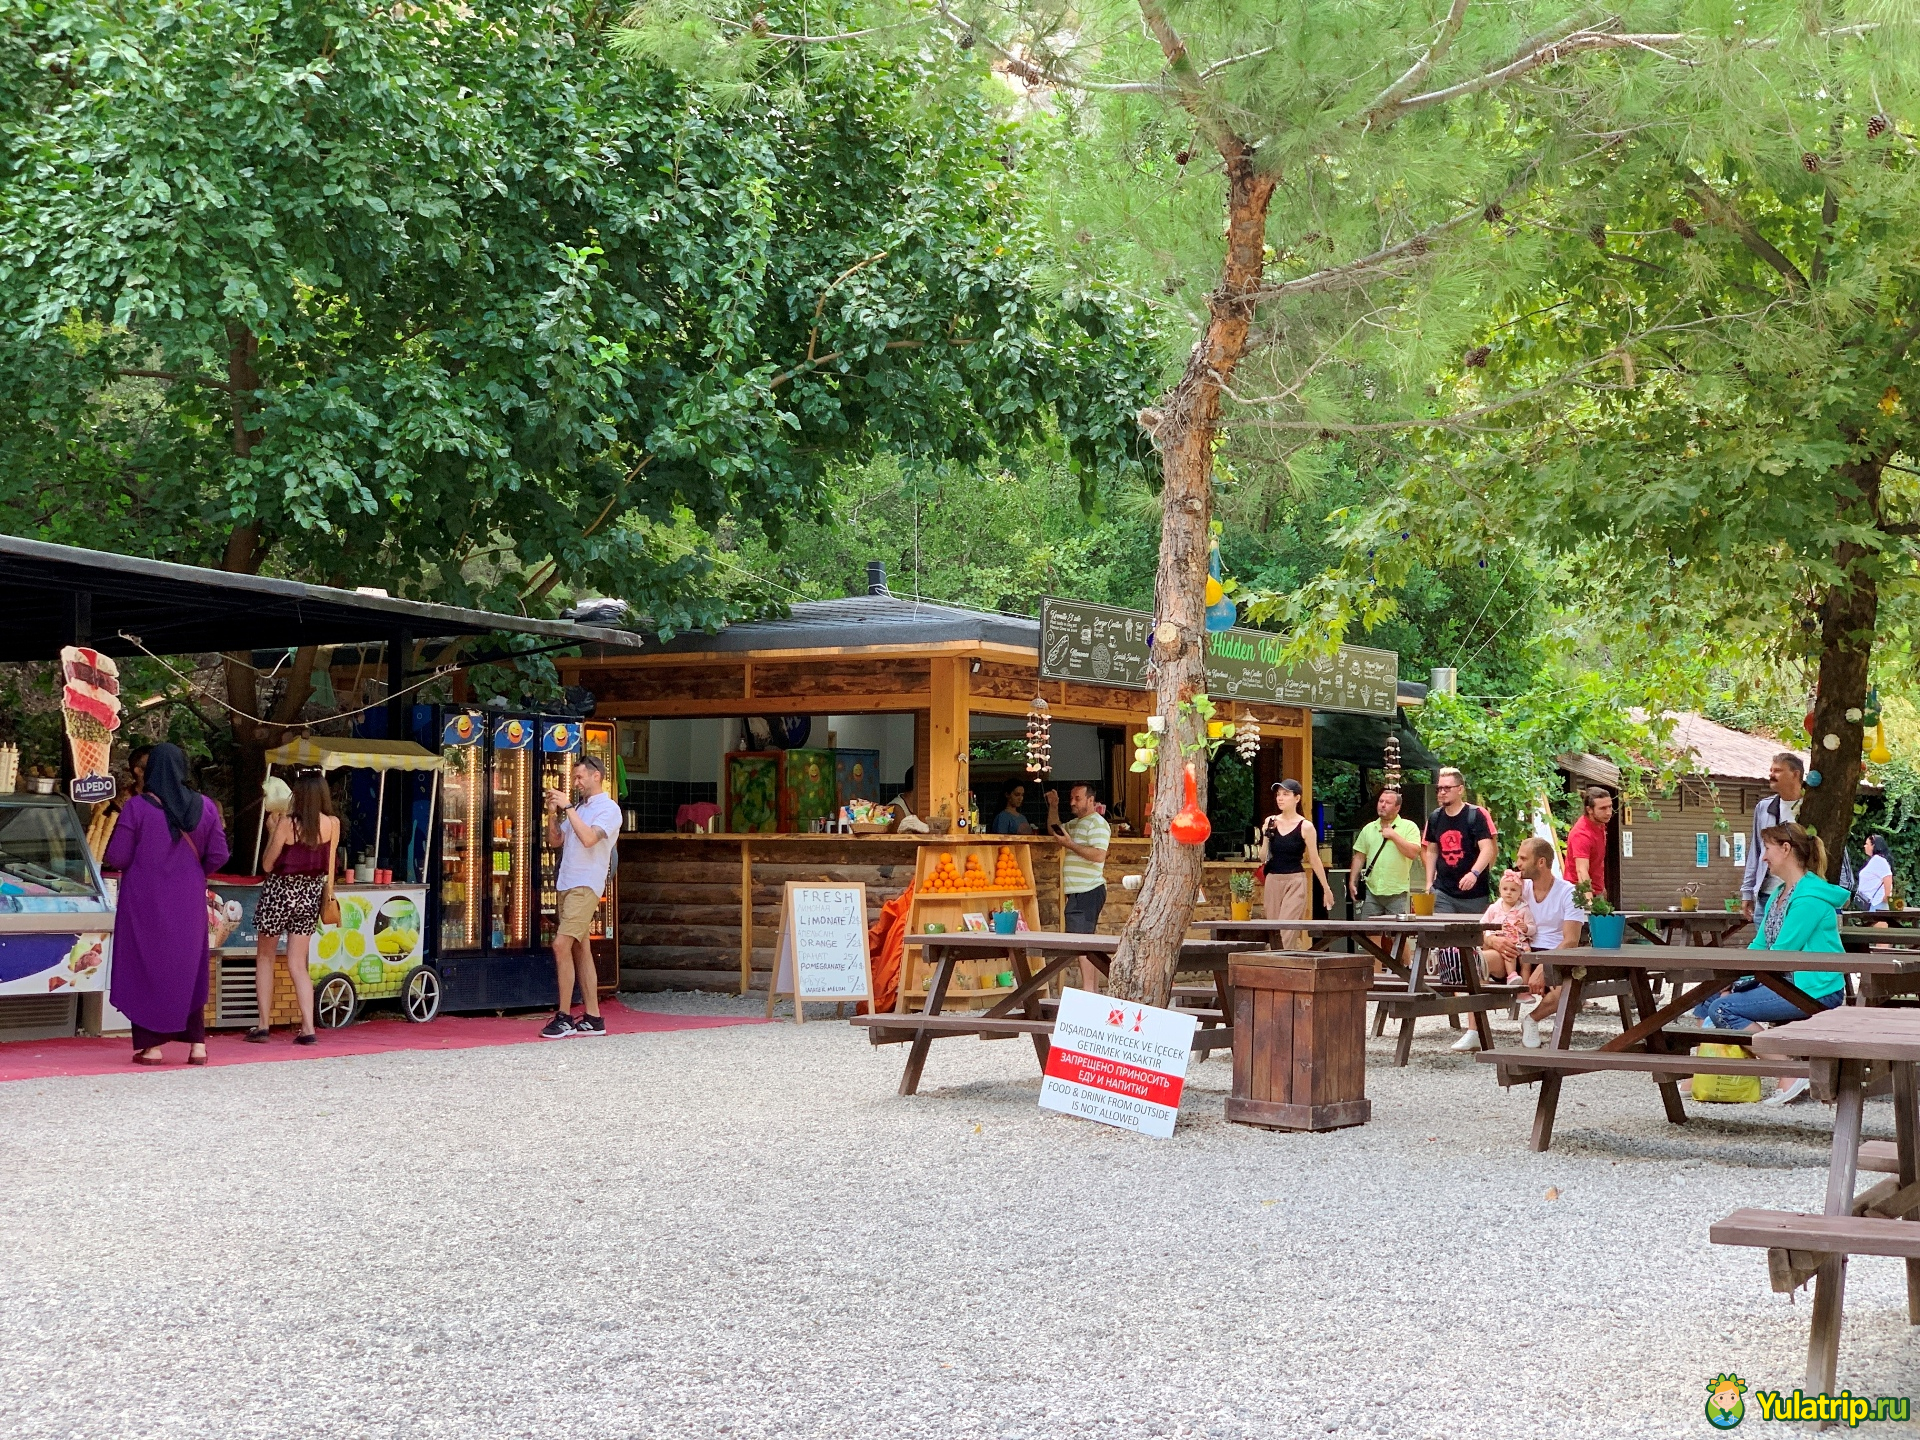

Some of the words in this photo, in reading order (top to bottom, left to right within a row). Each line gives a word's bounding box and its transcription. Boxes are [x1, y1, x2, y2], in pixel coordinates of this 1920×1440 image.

[1209, 631, 1256, 662] Hidden
[1258, 637, 1294, 677] Vally
[75, 780, 112, 793] ALPEDO
[802, 890, 853, 904] FRESH
[800, 940, 838, 948] ORANGE
[1060, 1022, 1105, 1041] DIŞARIDAN
[1107, 1032, 1140, 1051] YİYECEK
[1141, 1041, 1152, 1052] VE
[1155, 1042, 1185, 1060] İÇECEK
[1077, 1040, 1120, 1059] GETİRMEK
[1122, 1051, 1162, 1069] YASAKTIR
[1060, 1052, 1114, 1074] ЗАПРЕЩЕНО
[1115, 1066, 1170, 1088] ПРИНОСИТЬ
[1078, 1070, 1096, 1083] ЕДУ
[1096, 1075, 1104, 1084] И
[1105, 1077, 1148, 1097] НАПИТКИ
[1048, 1081, 1071, 1095] FOOD
[1072, 1088, 1079, 1097] &
[1081, 1089, 1106, 1104] DRINK
[1107, 1097, 1133, 1111] FROM
[1134, 1103, 1170, 1121] OUTSIDE
[1071, 1101, 1079, 1110] IS
[1080, 1103, 1098, 1115] NOT
[1099, 1108, 1139, 1127] ALLOWED
